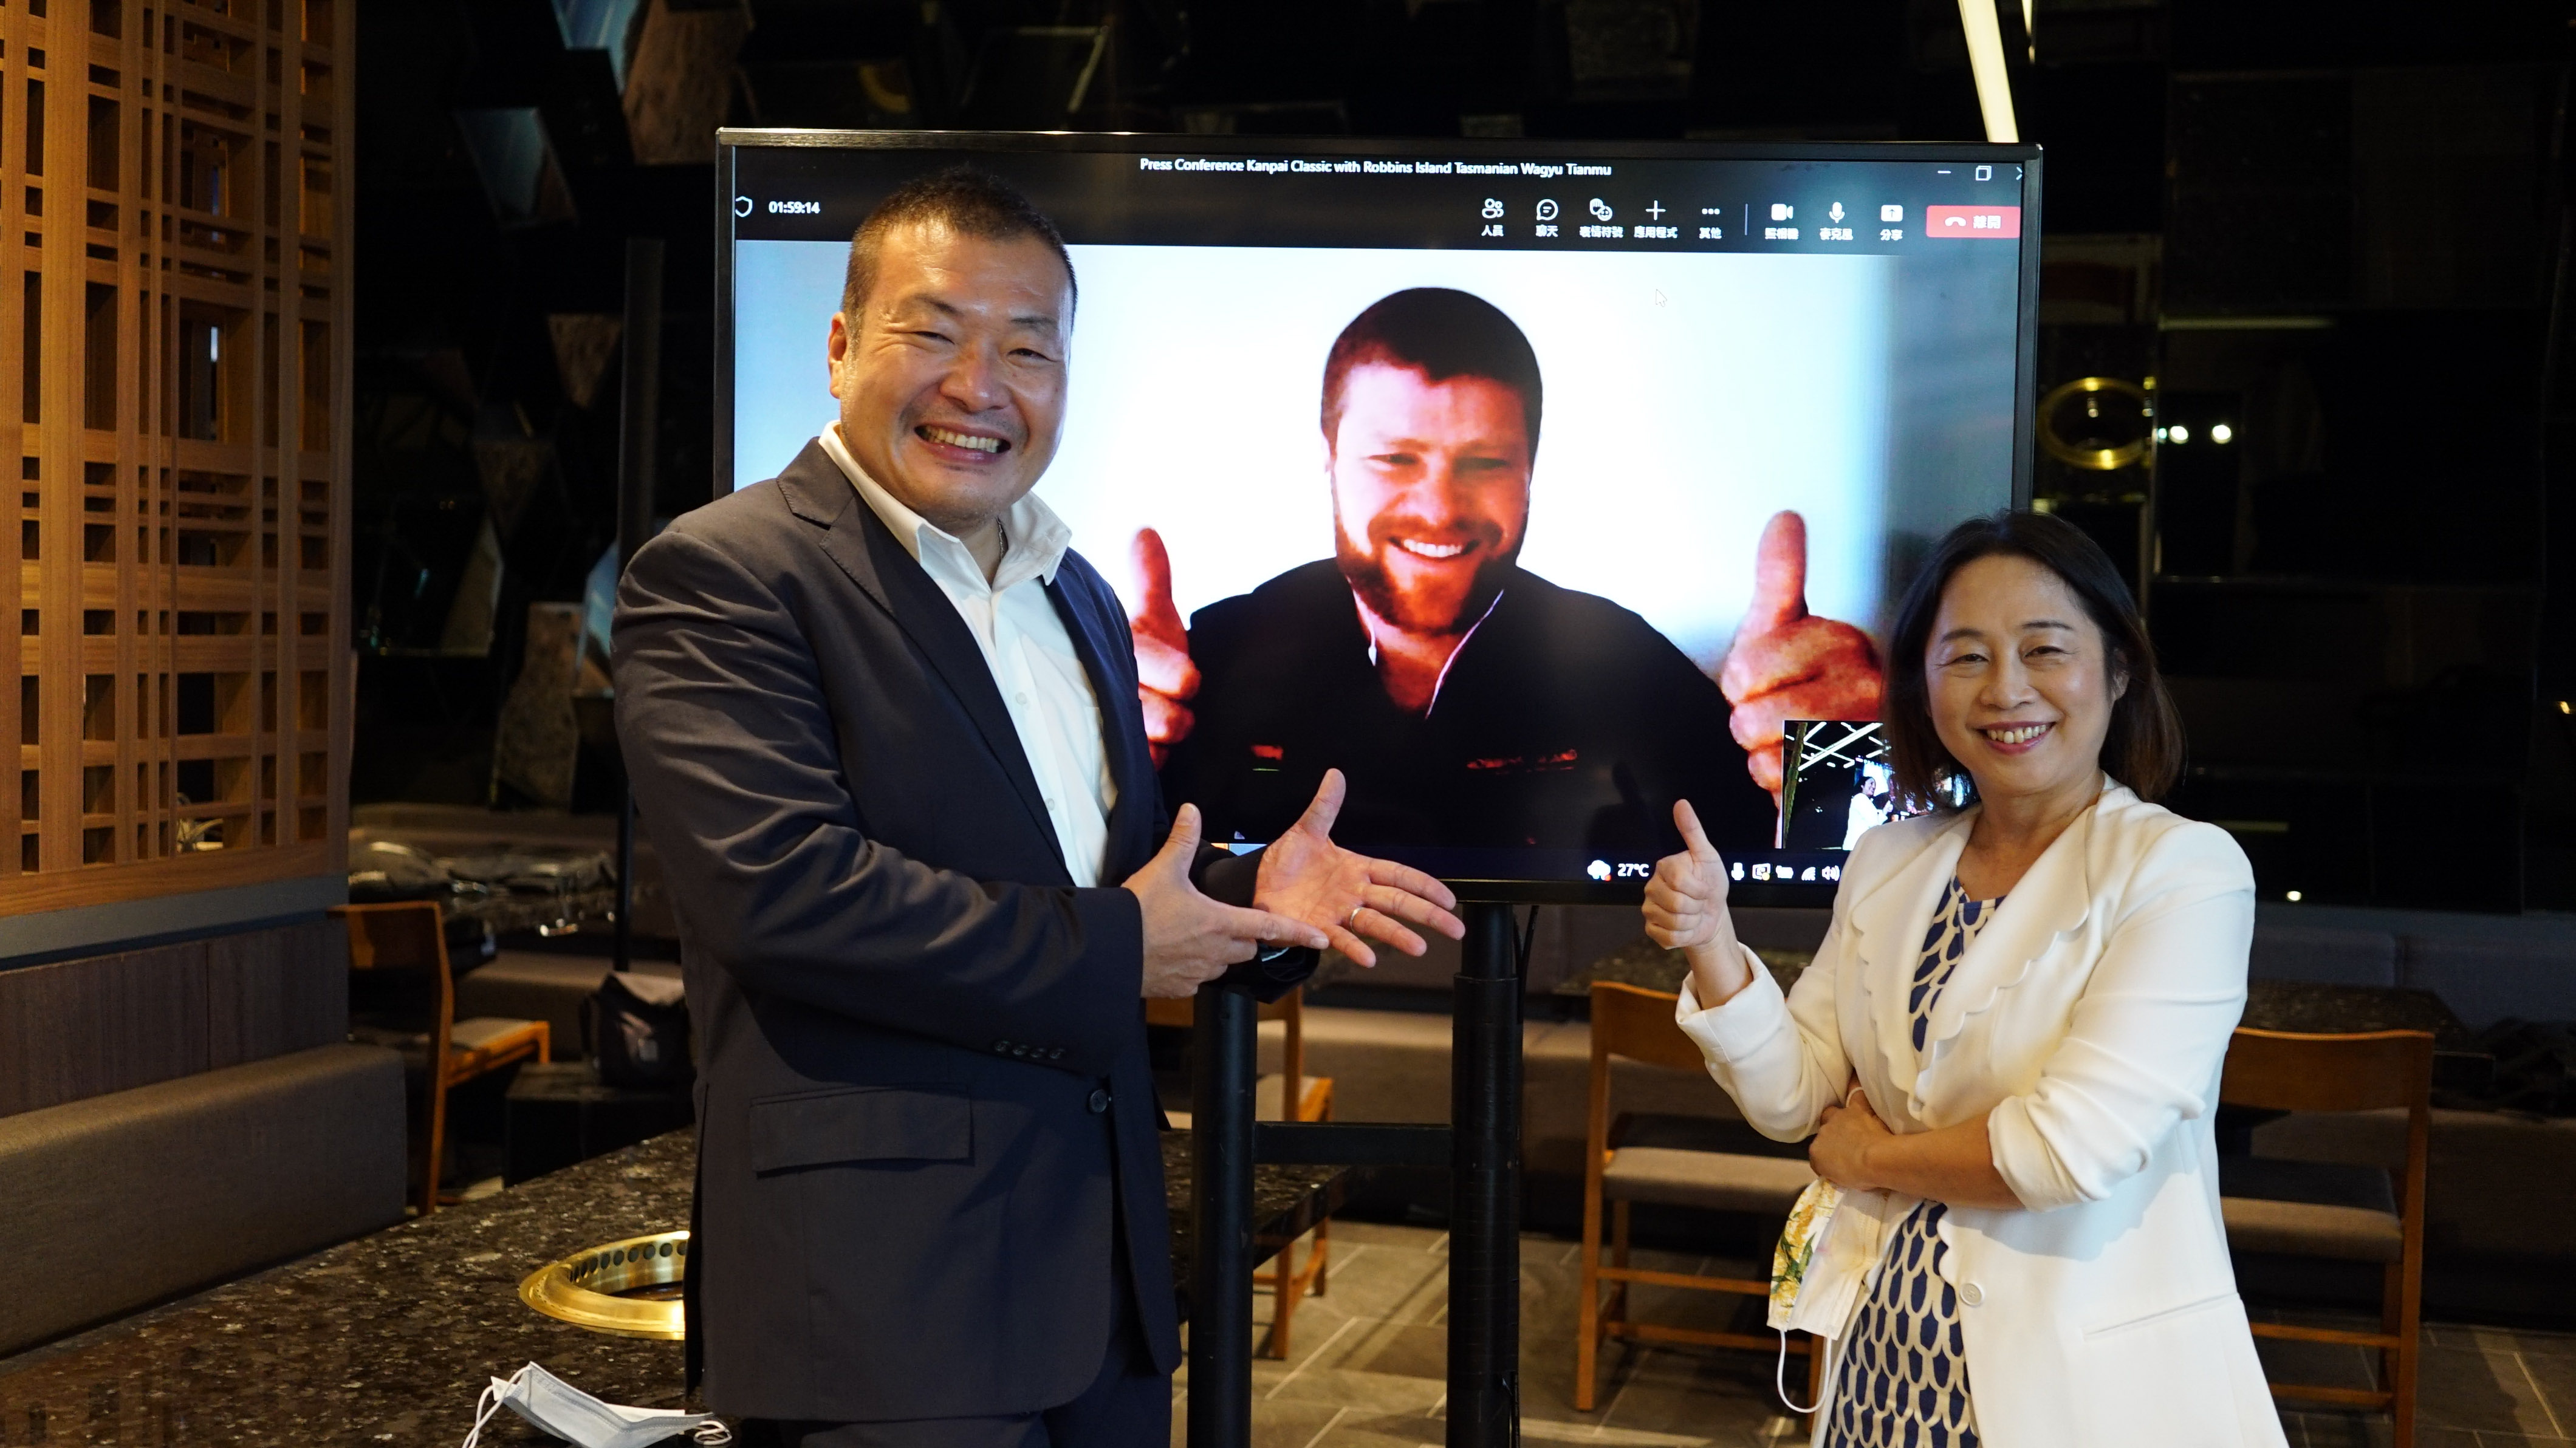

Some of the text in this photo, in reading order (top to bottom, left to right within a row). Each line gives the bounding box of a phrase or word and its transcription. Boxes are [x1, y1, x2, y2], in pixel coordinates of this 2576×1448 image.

[1140, 158, 1612, 178] Press Conference Kanpai Classic with Robbins Island Tasmanian Wagyu Tianmu
[768, 200, 821, 214] 01:59:14
[1481, 224, 1504, 237] 人員
[1535, 224, 1558, 237] 聊天
[1633, 225, 1678, 239] 應用程式
[1699, 227, 1722, 239] 其他
[1879, 228, 1903, 241] 分享
[1617, 863, 1649, 877] 27°C
